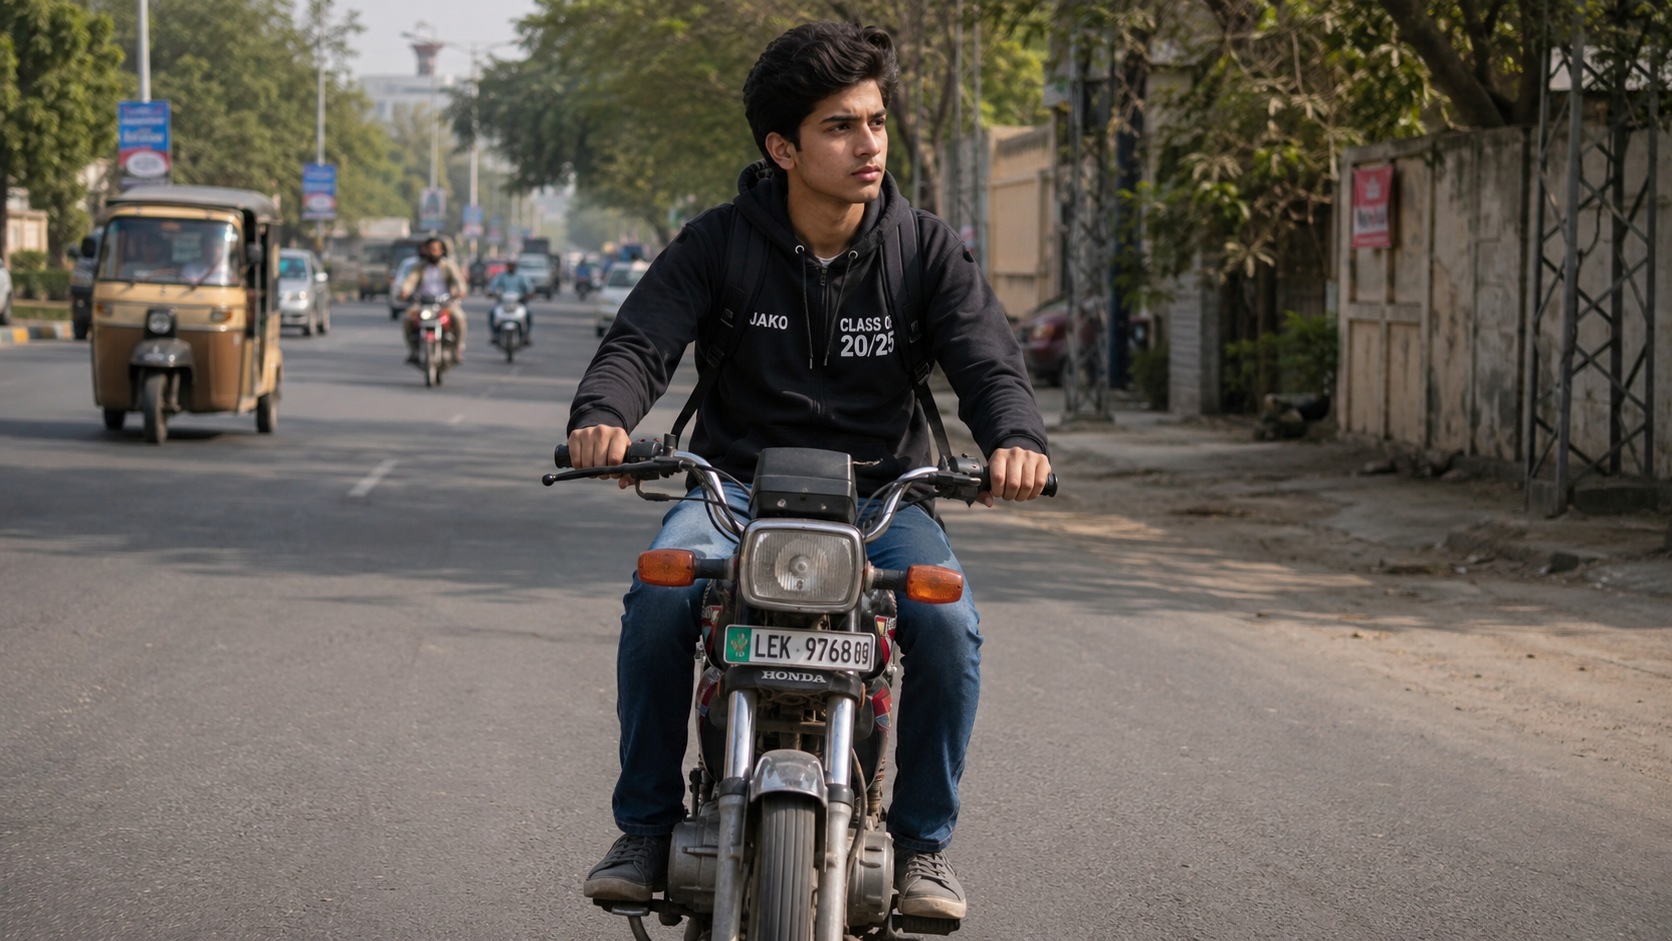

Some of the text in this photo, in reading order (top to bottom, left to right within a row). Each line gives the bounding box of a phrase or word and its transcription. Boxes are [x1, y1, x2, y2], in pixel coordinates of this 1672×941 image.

[750, 312, 788, 330] JAKO
[840, 316, 892, 332] CLASS O
[841, 331, 894, 357] 20/25
[754, 634, 792, 660] LEK
[805, 637, 852, 663] 9768
[761, 670, 827, 684] HONDA
